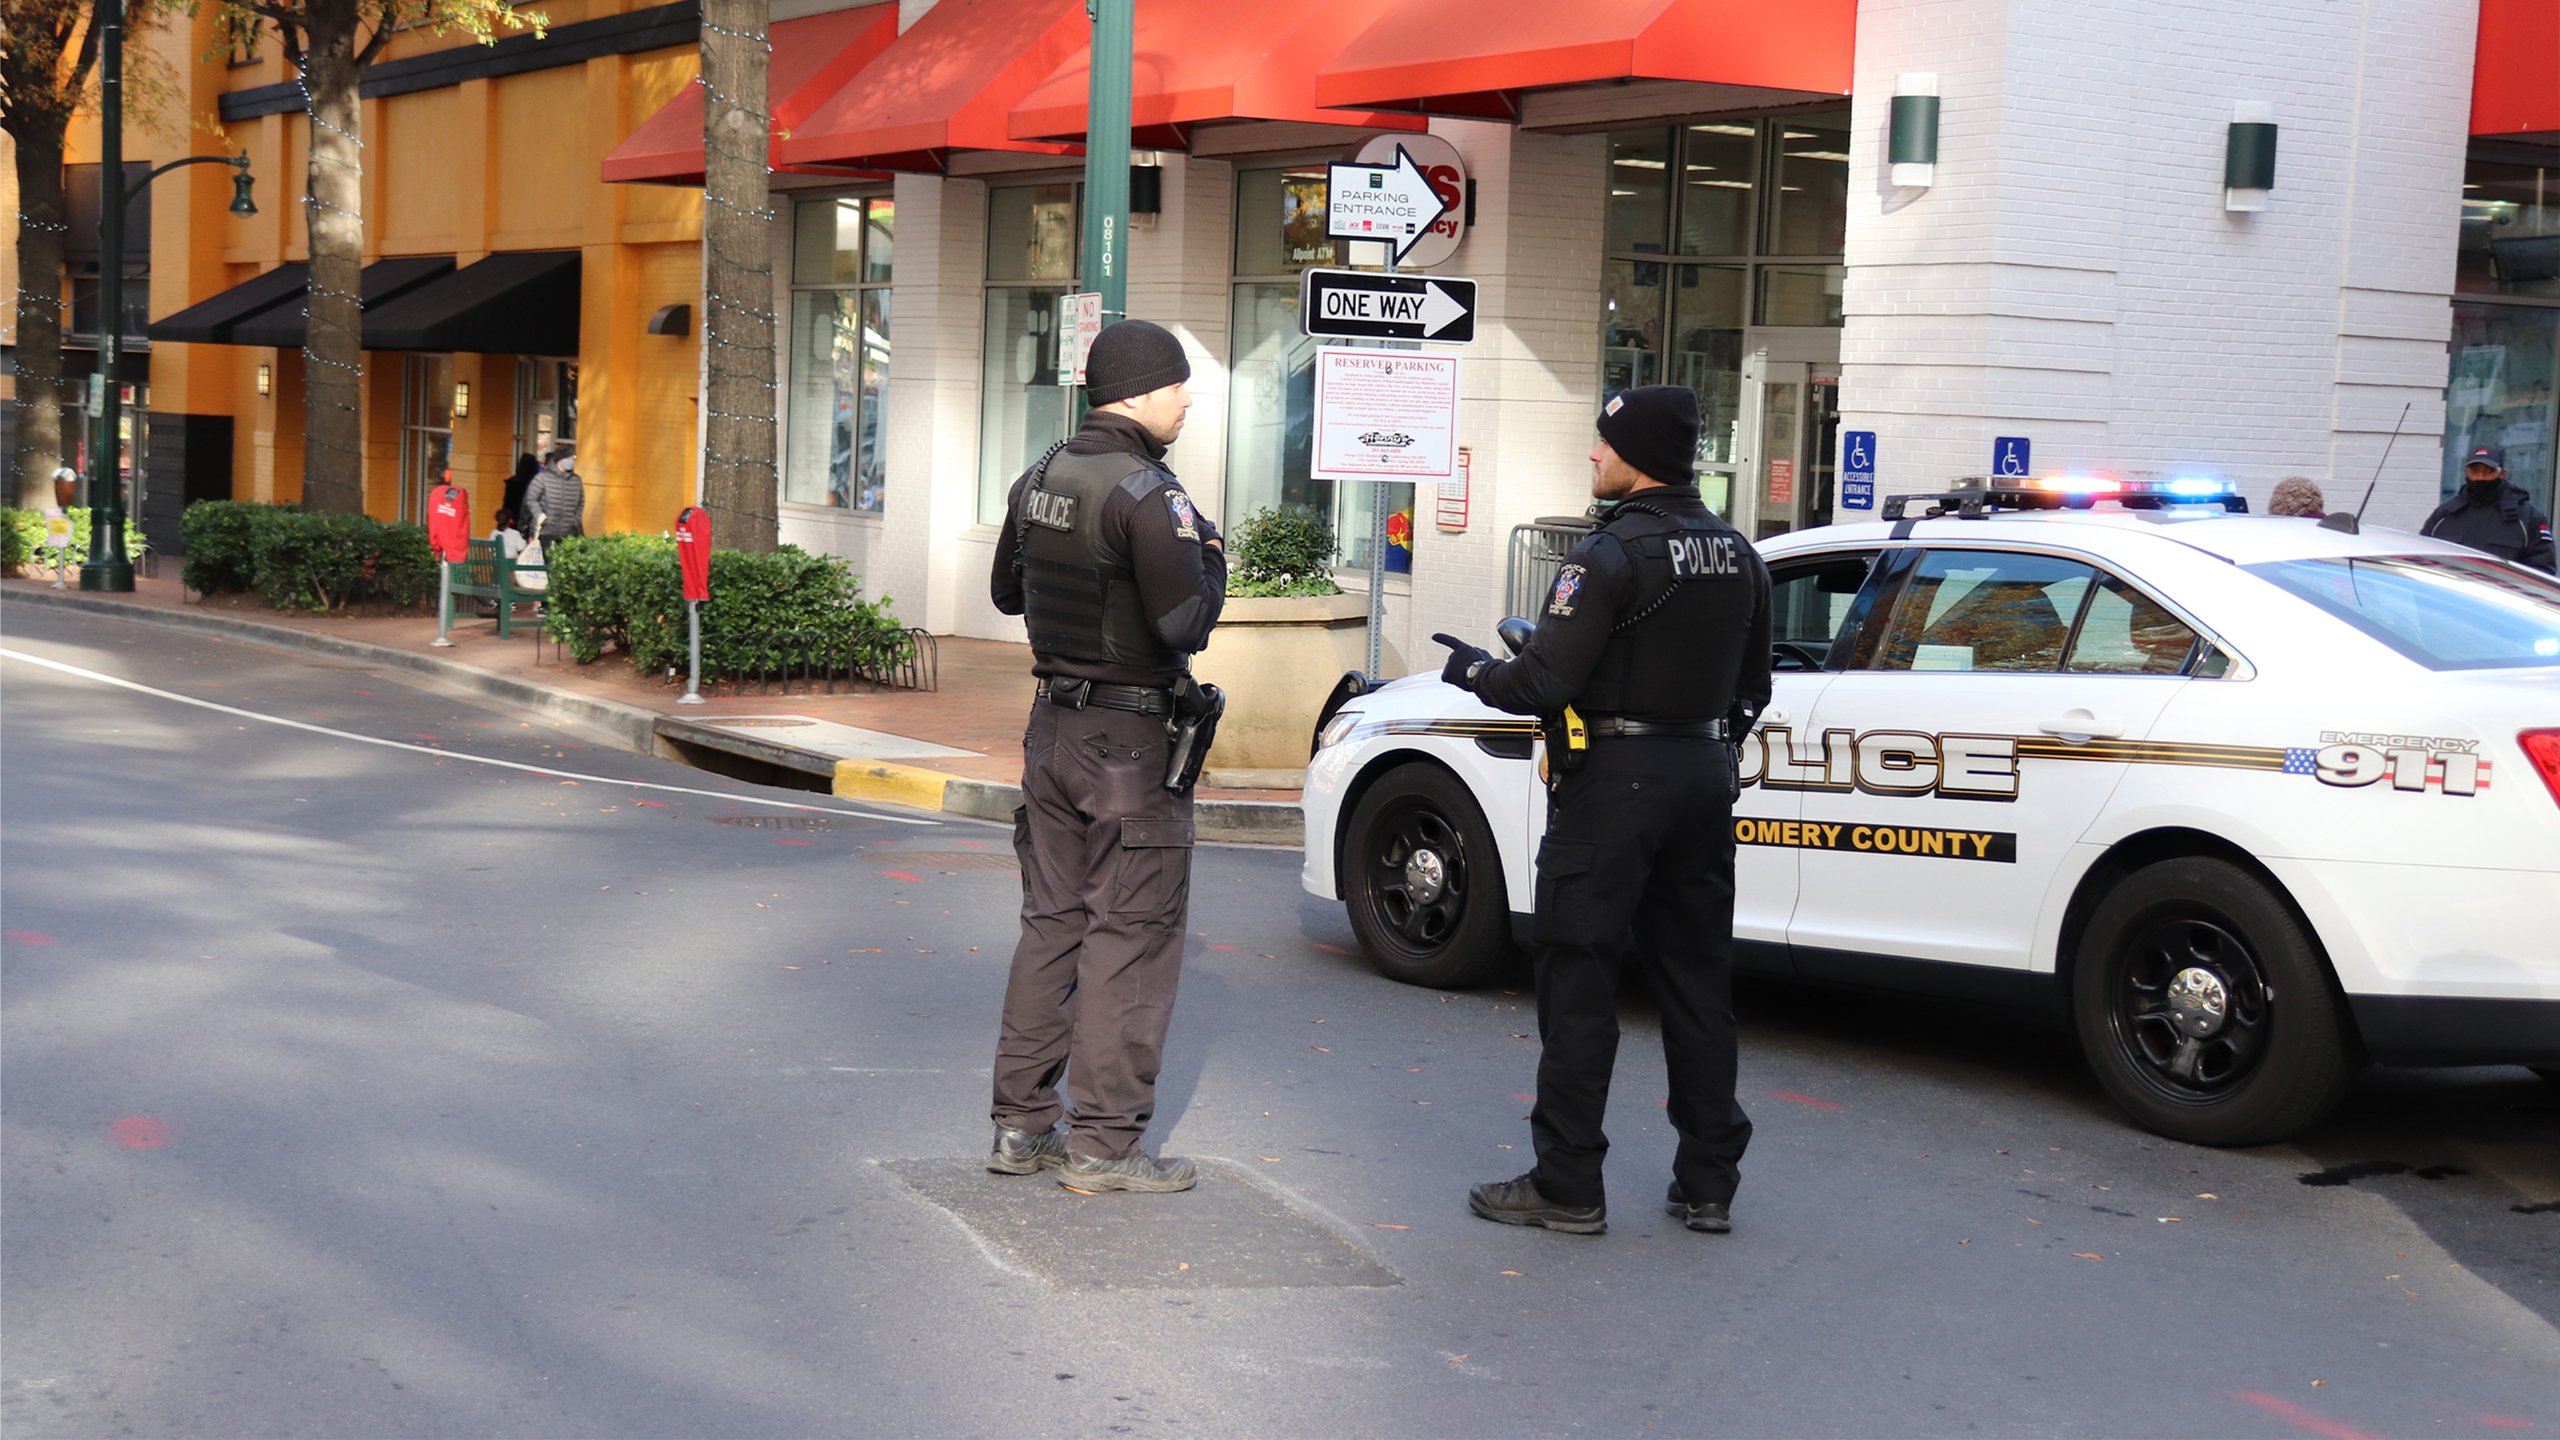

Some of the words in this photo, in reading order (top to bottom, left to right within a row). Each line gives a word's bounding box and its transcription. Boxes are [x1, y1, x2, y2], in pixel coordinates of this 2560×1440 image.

[1341, 191, 1409, 204] PARKING
[1333, 203, 1417, 217] ENTRANCE
[1102, 216, 1113, 276] 08101
[1316, 246, 1333, 260] ATM
[1083, 301, 1095, 317] NO
[1327, 292, 1370, 317] ONE
[1380, 295, 1425, 320] WAY
[1335, 357, 1393, 370] RESERVED
[1394, 360, 1445, 373] PARKING
[1843, 471, 1874, 483] ACCESSIBLE
[1843, 484, 1872, 496] ENTRANCE
[1667, 536, 1739, 575] POLICE
[2319, 730, 2480, 752] EMERGENCY
[2314, 743, 2480, 797] 911
[1851, 826, 1993, 858] COUNTY
